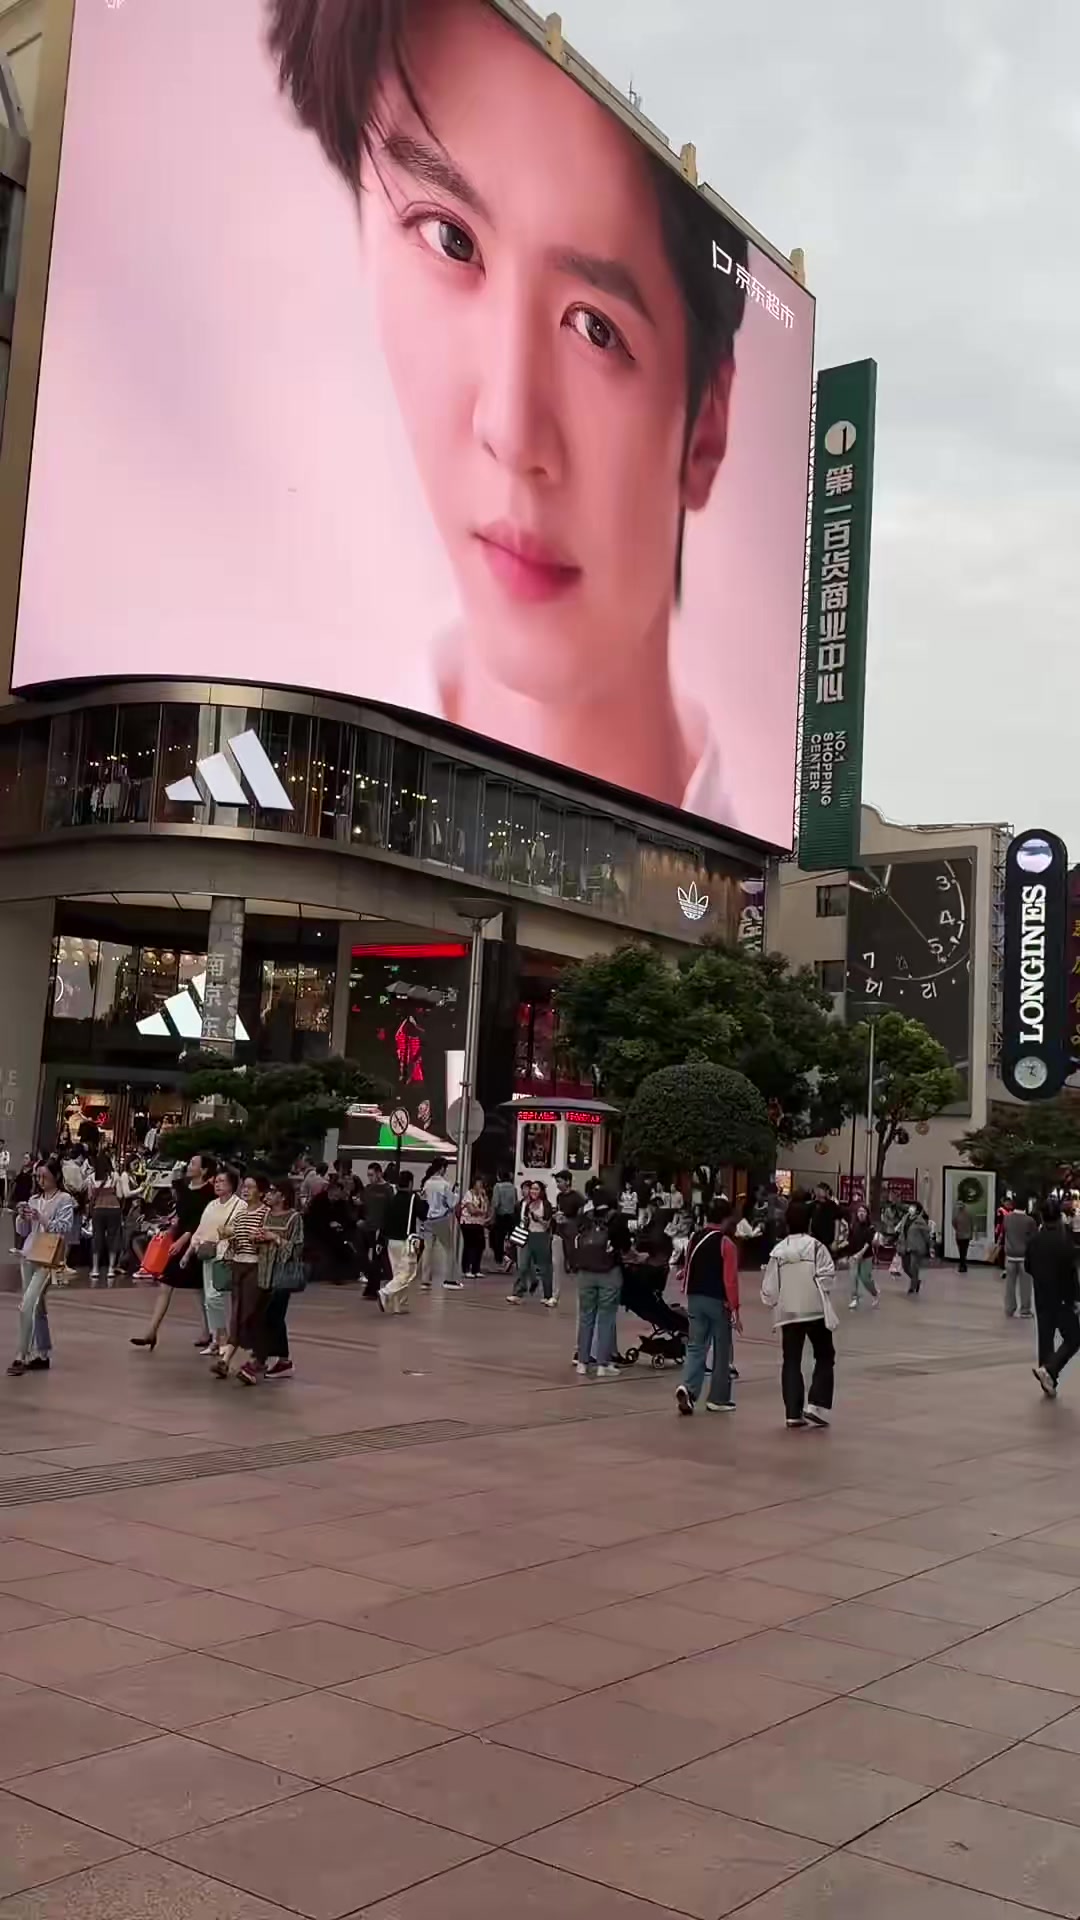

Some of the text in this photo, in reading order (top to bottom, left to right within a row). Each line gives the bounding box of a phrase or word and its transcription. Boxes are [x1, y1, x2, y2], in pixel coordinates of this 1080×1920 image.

[735, 262, 795, 329] 京东超市
[816, 463, 853, 704] 第一百货商业中心
[809, 734, 821, 791] CENTER
[834, 730, 847, 762] NO.1
[820, 732, 834, 806] SHOPPING
[935, 875, 951, 891] 3
[939, 909, 955, 925] 4
[862, 951, 875, 969] 7
[927, 937, 943, 954] 5
[1019, 883, 1046, 1044] LONGINES
